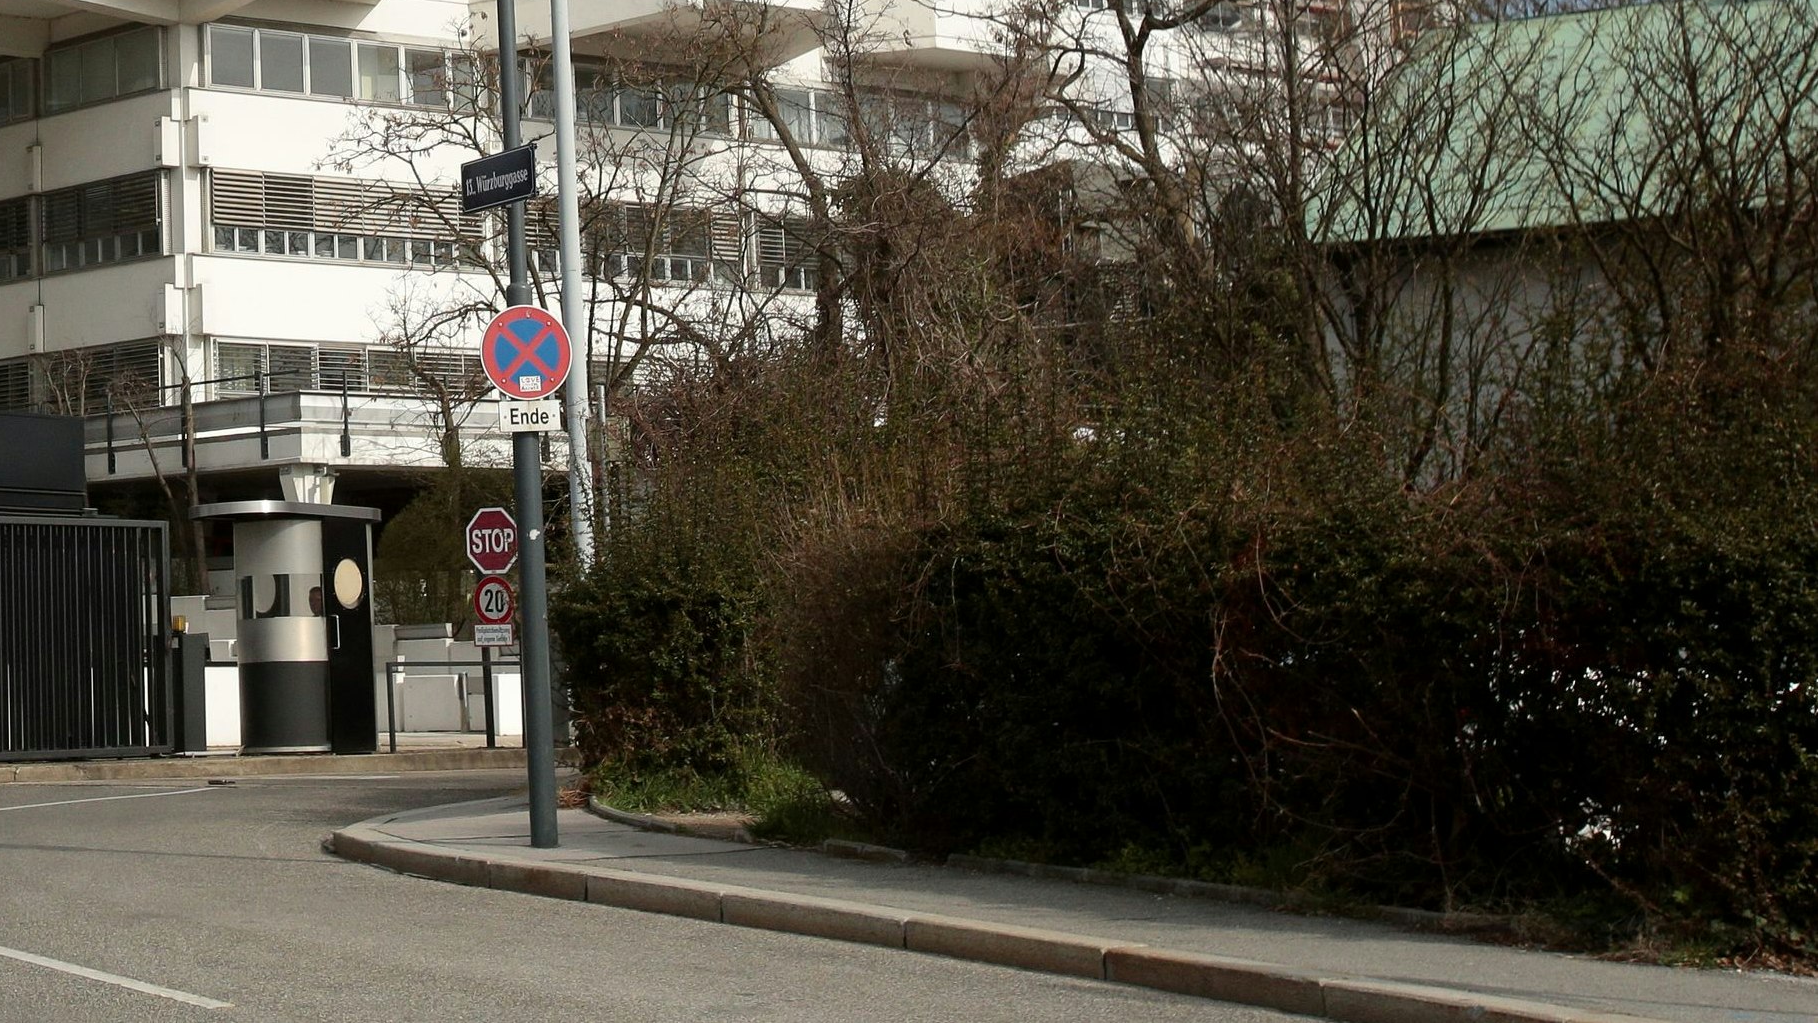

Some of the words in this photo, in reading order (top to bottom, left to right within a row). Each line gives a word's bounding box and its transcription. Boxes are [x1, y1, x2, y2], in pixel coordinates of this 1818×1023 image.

[476, 169, 528, 193] Würzburggasse
[510, 408, 549, 425] Ende
[472, 528, 514, 553] STOP
[485, 589, 504, 613] 20
